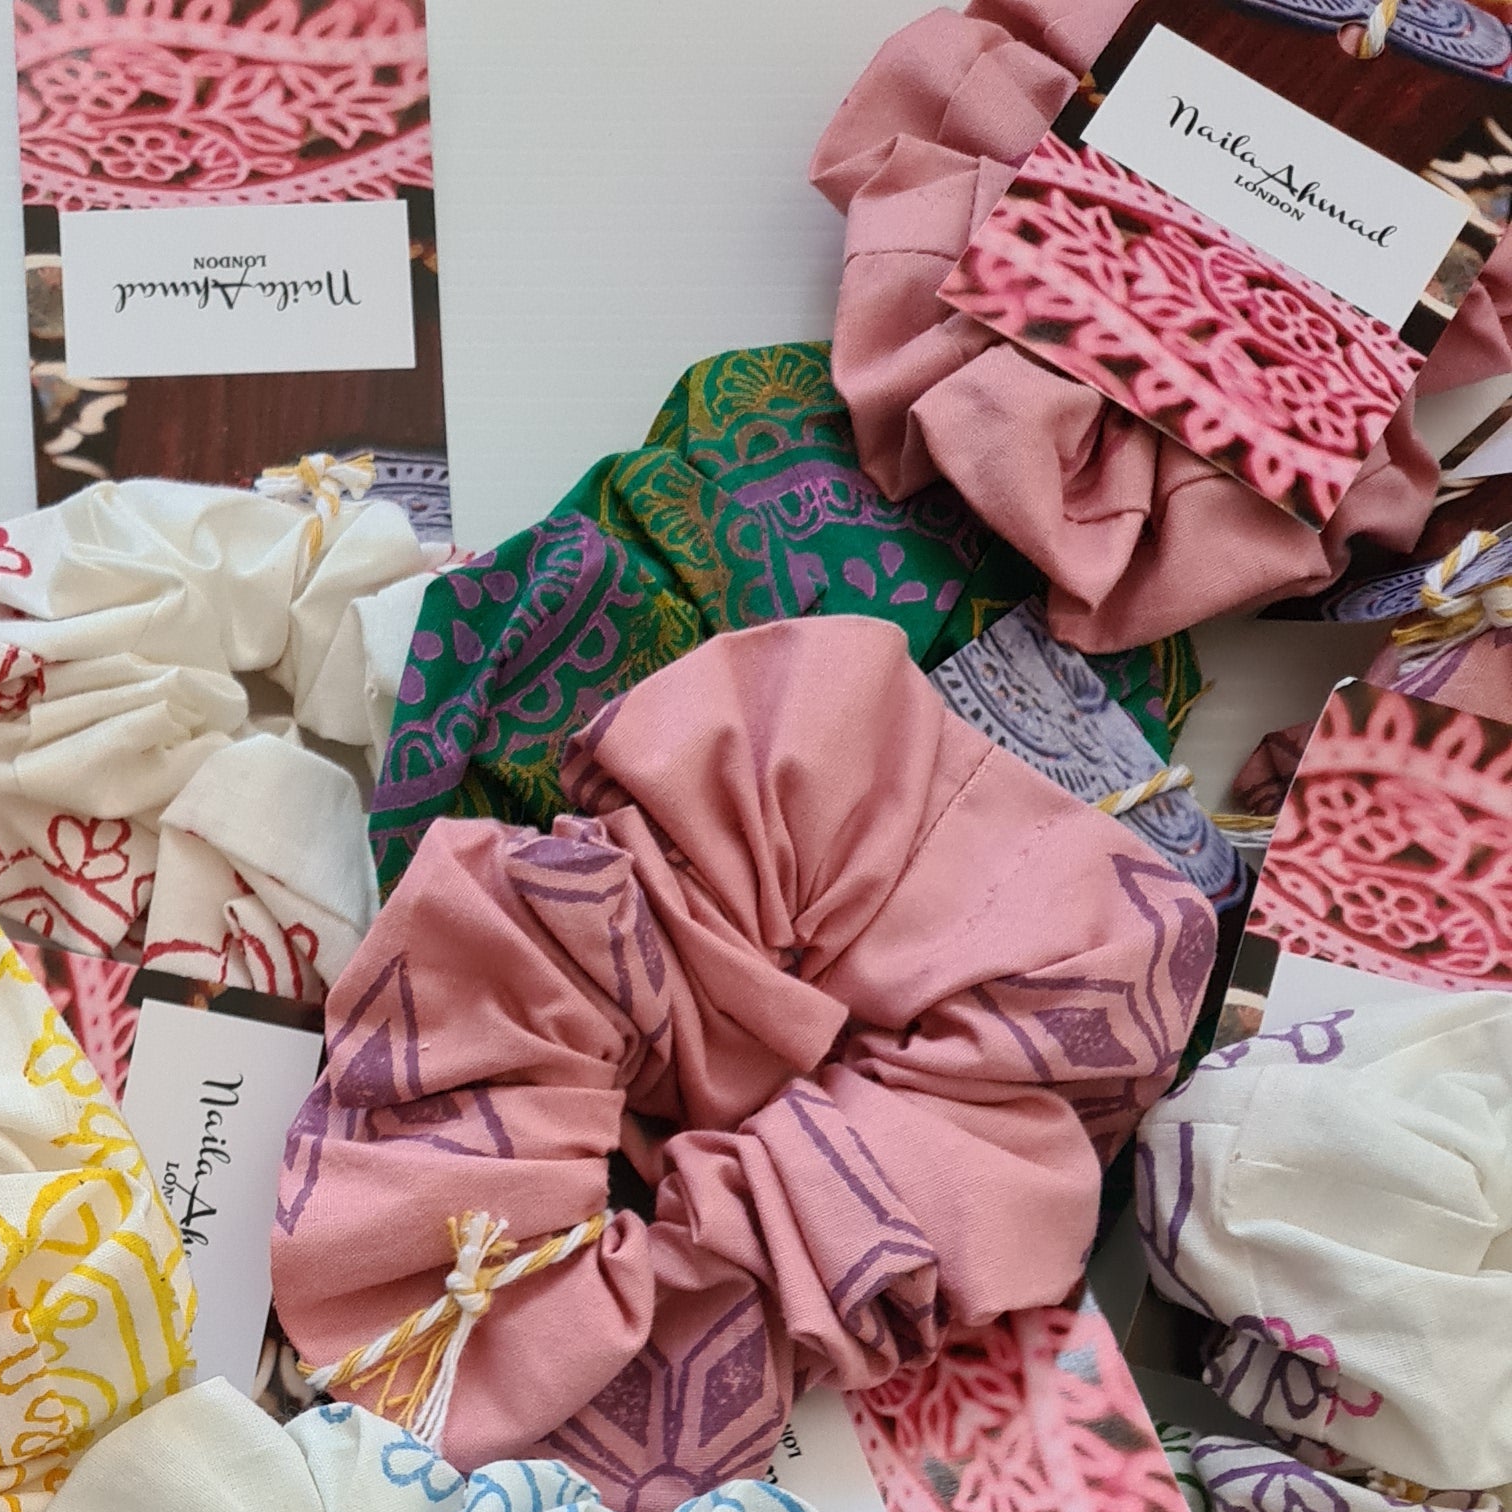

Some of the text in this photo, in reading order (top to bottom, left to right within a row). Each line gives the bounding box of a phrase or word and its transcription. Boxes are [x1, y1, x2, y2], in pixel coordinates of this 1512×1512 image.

[1167, 95, 1399, 249] Naila Ahmad
[1233, 174, 1306, 222] LONDON
[193, 255, 267, 270] LONDON
[113, 266, 361, 313] Naila Ahmad
[194, 1073, 244, 1182] Naila
